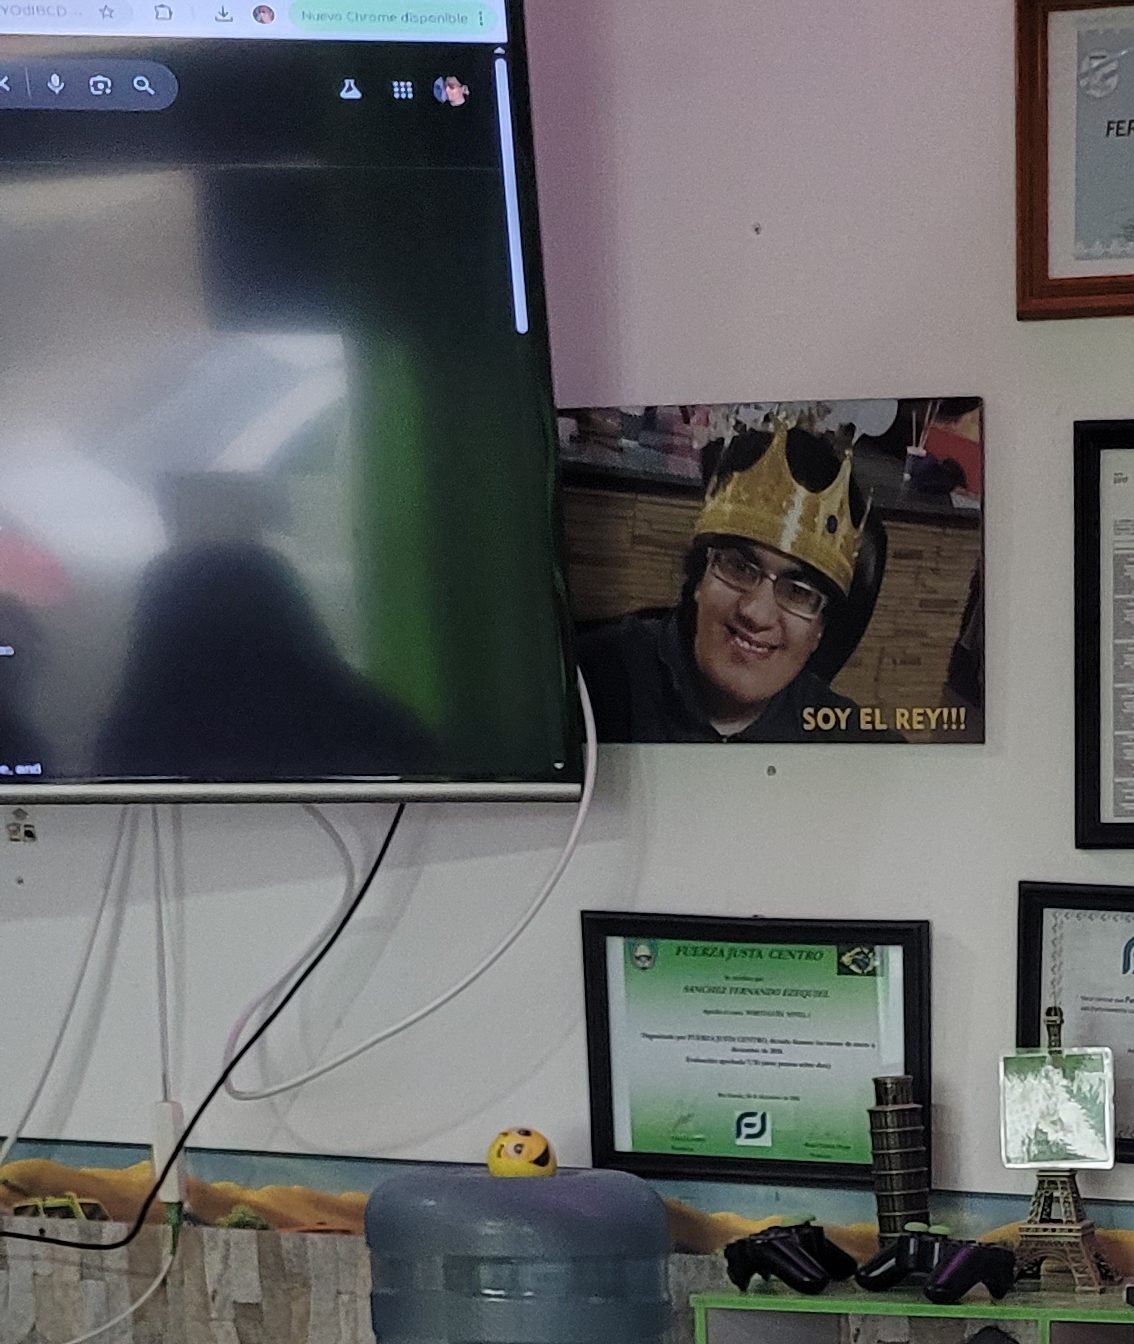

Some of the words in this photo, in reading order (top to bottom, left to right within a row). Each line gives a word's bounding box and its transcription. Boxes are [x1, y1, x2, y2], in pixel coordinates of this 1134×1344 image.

[301, 10, 342, 22] Nuevo
[346, 11, 397, 23] Chrome
[401, 12, 468, 26] disponible
[802, 706, 852, 731] SOY
[859, 706, 889, 731] EL
[894, 706, 967, 731] REY!!!
